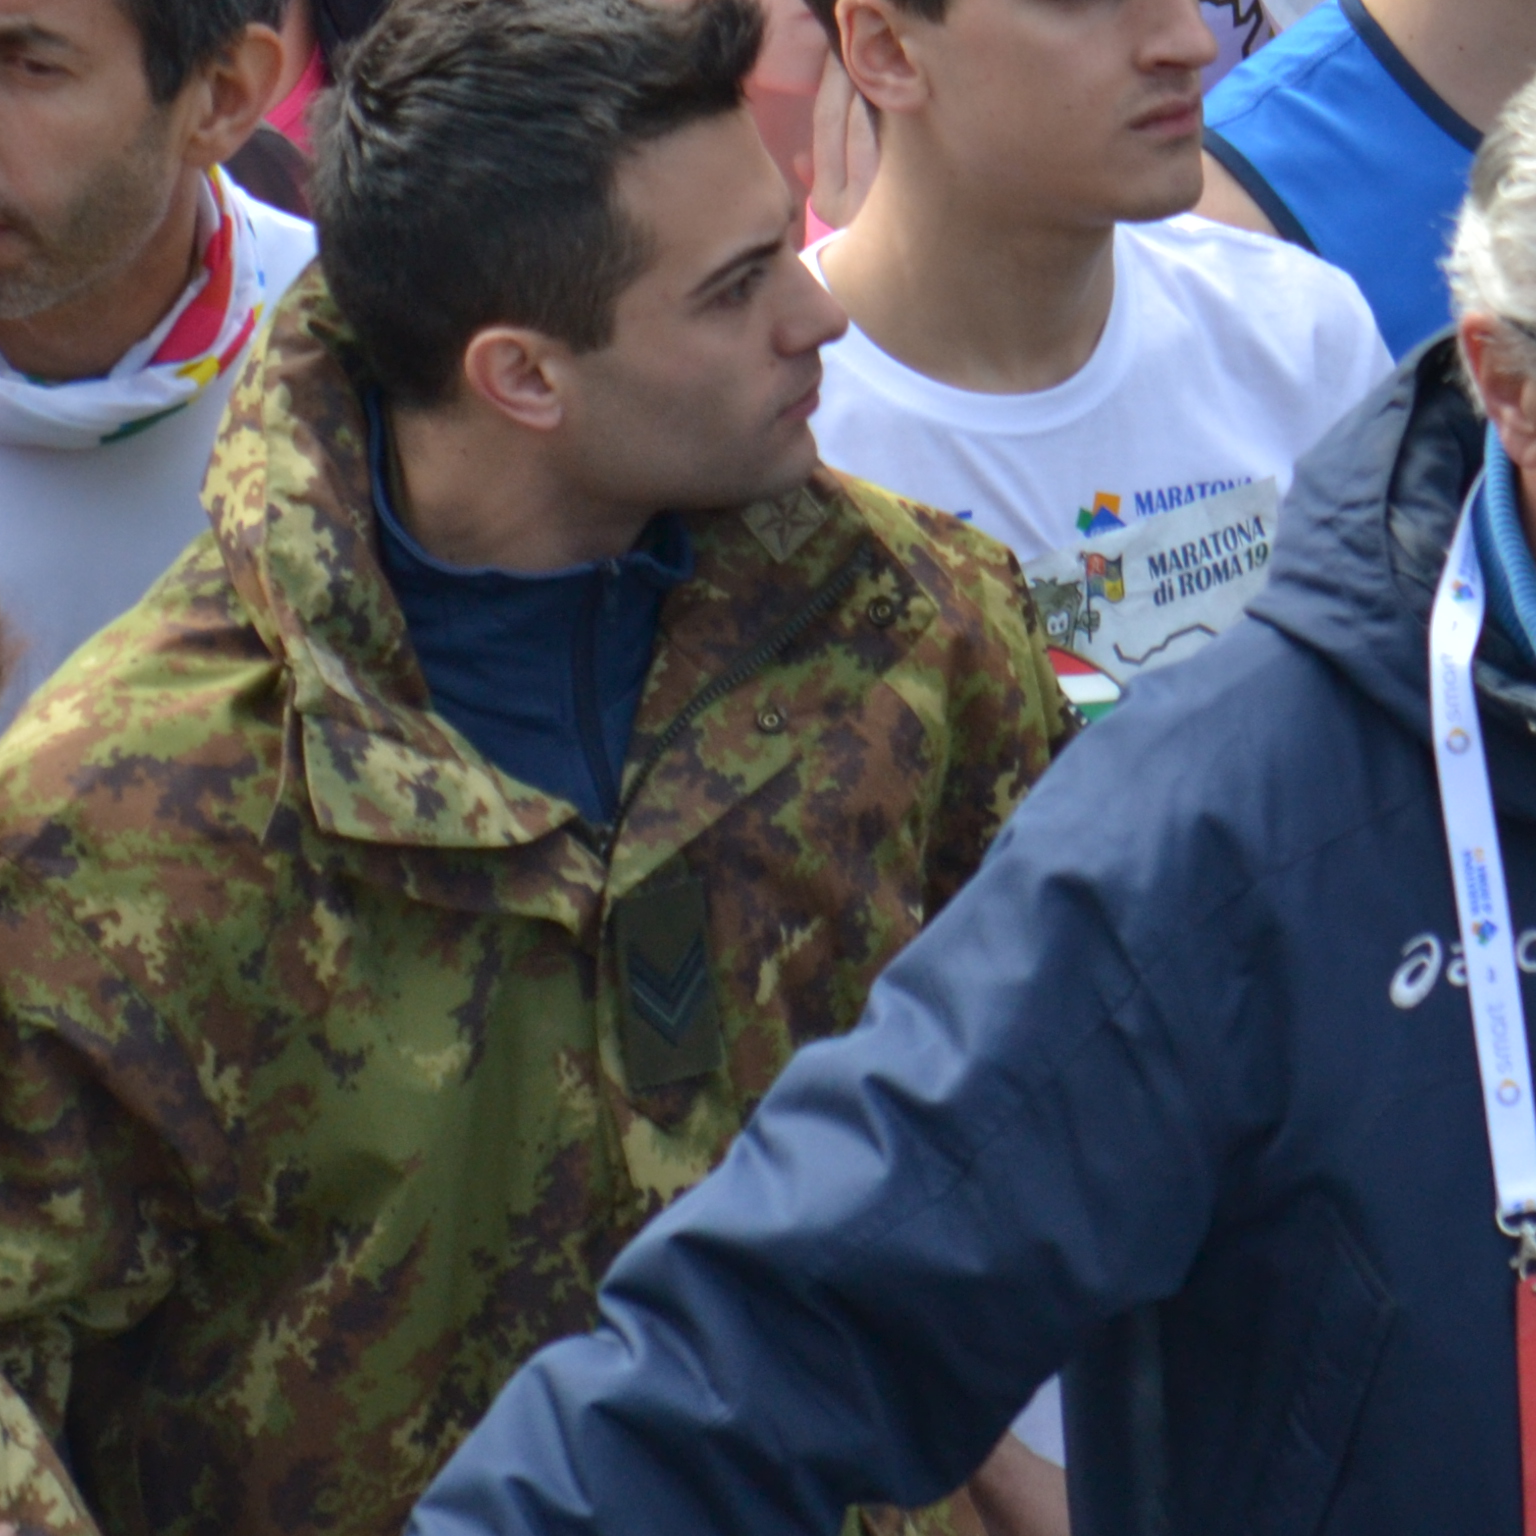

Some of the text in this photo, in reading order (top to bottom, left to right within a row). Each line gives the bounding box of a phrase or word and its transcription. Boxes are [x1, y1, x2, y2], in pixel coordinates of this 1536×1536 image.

[1148, 515, 1267, 580] MARATONA
[1153, 542, 1270, 607] di ROMA 19
